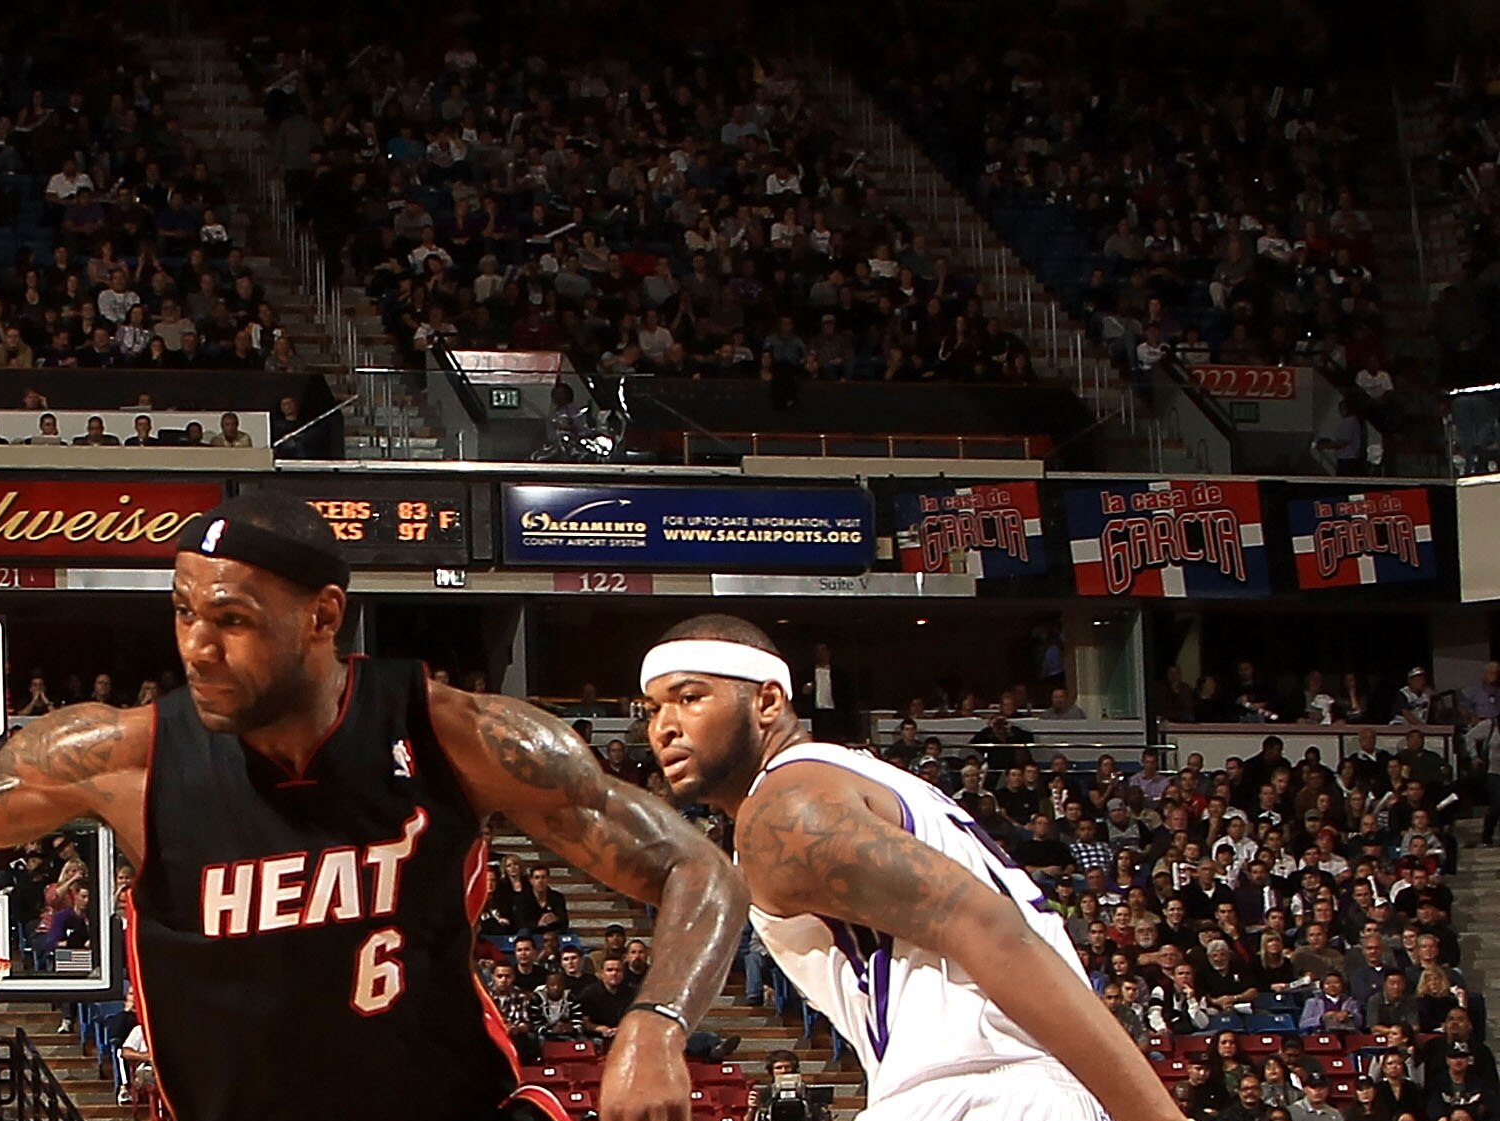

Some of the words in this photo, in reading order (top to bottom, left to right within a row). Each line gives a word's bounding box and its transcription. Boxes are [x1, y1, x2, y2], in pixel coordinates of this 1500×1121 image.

[1244, 370, 1293, 398] 223
[920, 494, 939, 512] la
[941, 493, 984, 510] casa
[987, 488, 1012, 507] de
[1101, 490, 1126, 515] la
[1131, 489, 1187, 512] casa
[1192, 482, 1222, 506] de
[1314, 501, 1333, 518] la
[1336, 500, 1377, 516] casa
[1379, 495, 1402, 513] de
[397, 521, 429, 541] 97
[521, 510, 647, 532] SACRAMENTO
[663, 516, 684, 526] FOR
[687, 516, 749, 527] UP-TO-DATE
[836, 518, 861, 528] VISIT
[523, 538, 563, 547] COUNTY
[567, 538, 606, 548] AIRPORT
[609, 539, 646, 548] SYSTEM
[663, 529, 862, 543] WWW.SACAIRPORTS.ORG
[1101, 509, 1247, 594] GARCIA
[579, 573, 628, 593] 122
[819, 577, 854, 592] Suite
[202, 807, 429, 938] HEAT
[351, 926, 405, 1017] 6
